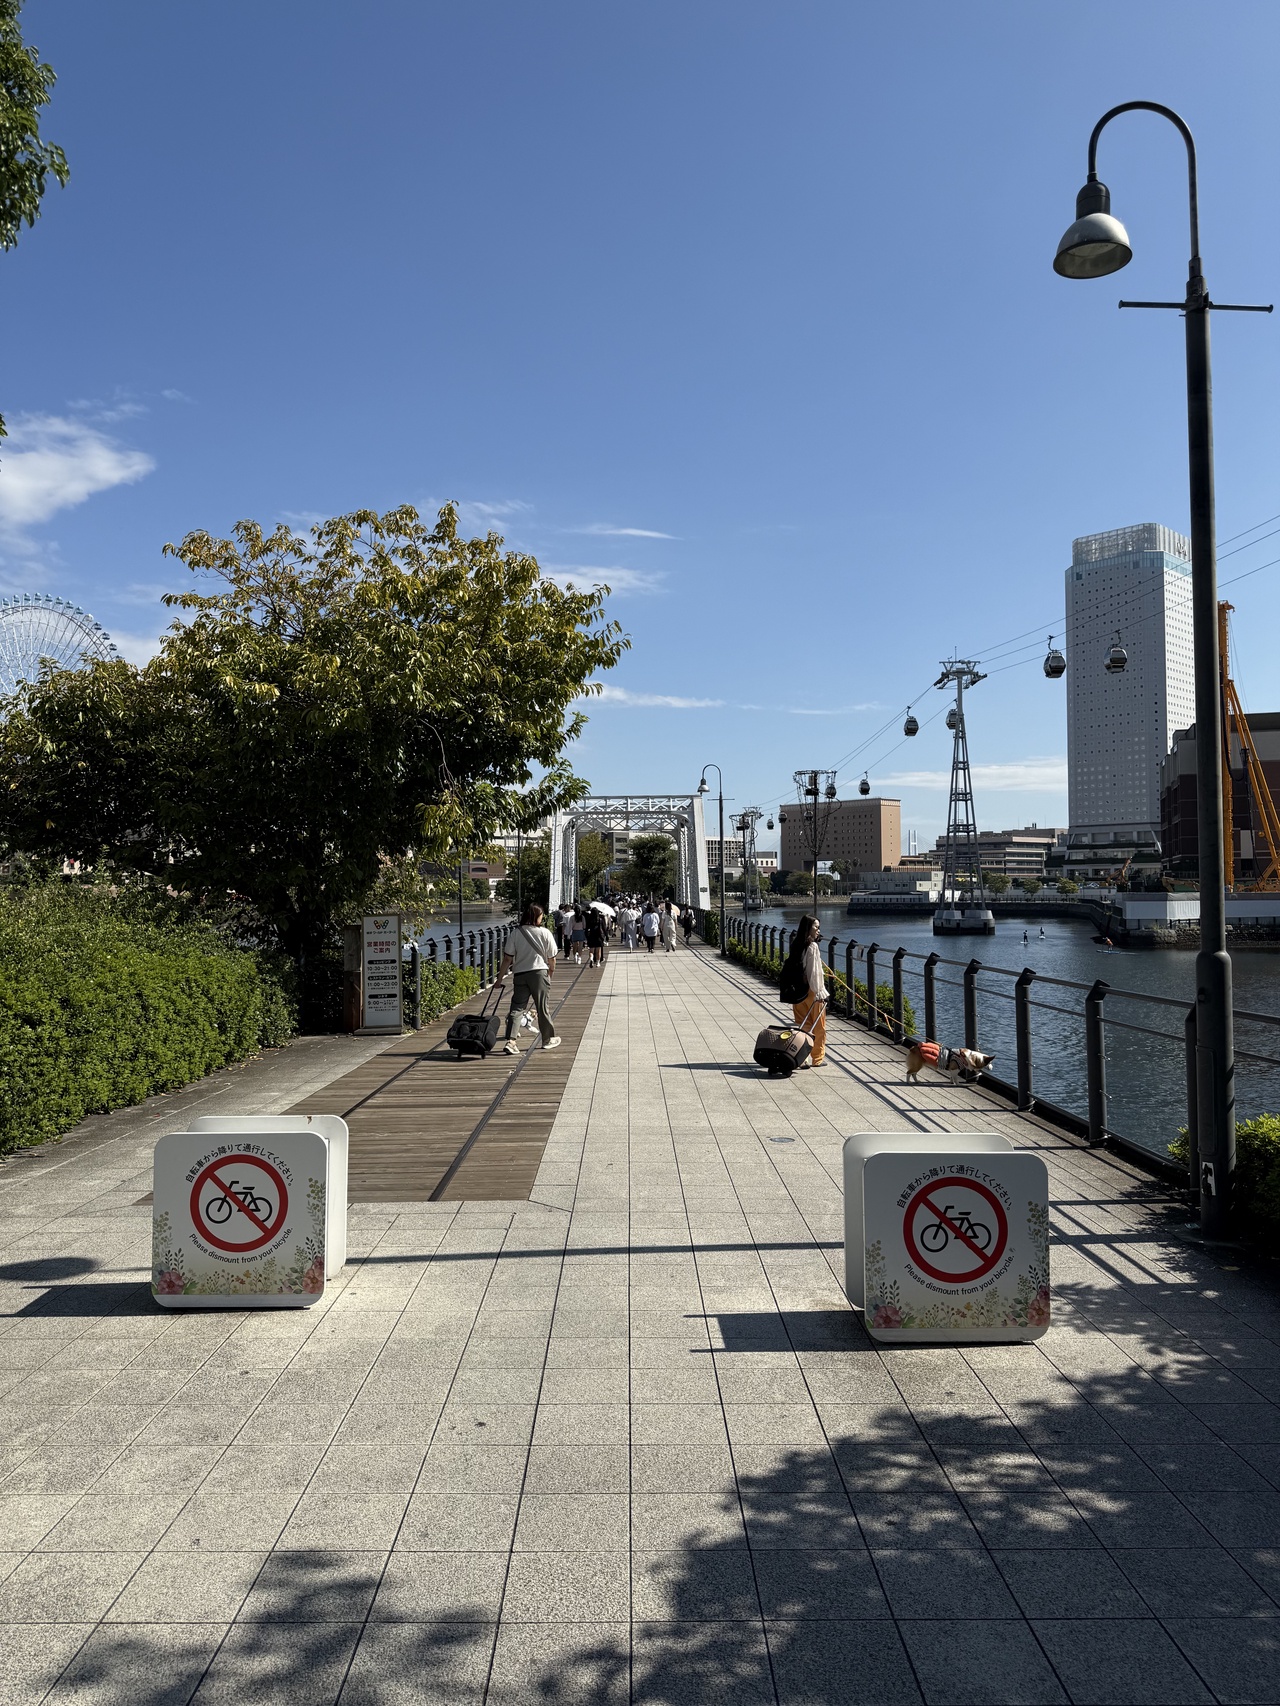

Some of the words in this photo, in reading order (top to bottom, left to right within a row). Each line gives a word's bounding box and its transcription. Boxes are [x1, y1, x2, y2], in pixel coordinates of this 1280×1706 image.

[185, 1143, 294, 1186] 自転車から降りて通行してください。
[896, 1164, 1013, 1211] 自転車から降りて通行してください。
[189, 1233, 208, 1254] Please
[208, 1251, 240, 1264] dismount
[241, 1255, 258, 1264] from
[259, 1246, 274, 1261] your
[272, 1227, 293, 1250] bicycle.
[904, 1263, 926, 1286] Please
[925, 1282, 960, 1296] dismount
[961, 1286, 979, 1295] from
[979, 1278, 995, 1292] your
[994, 1255, 1015, 1280] bicycle.
